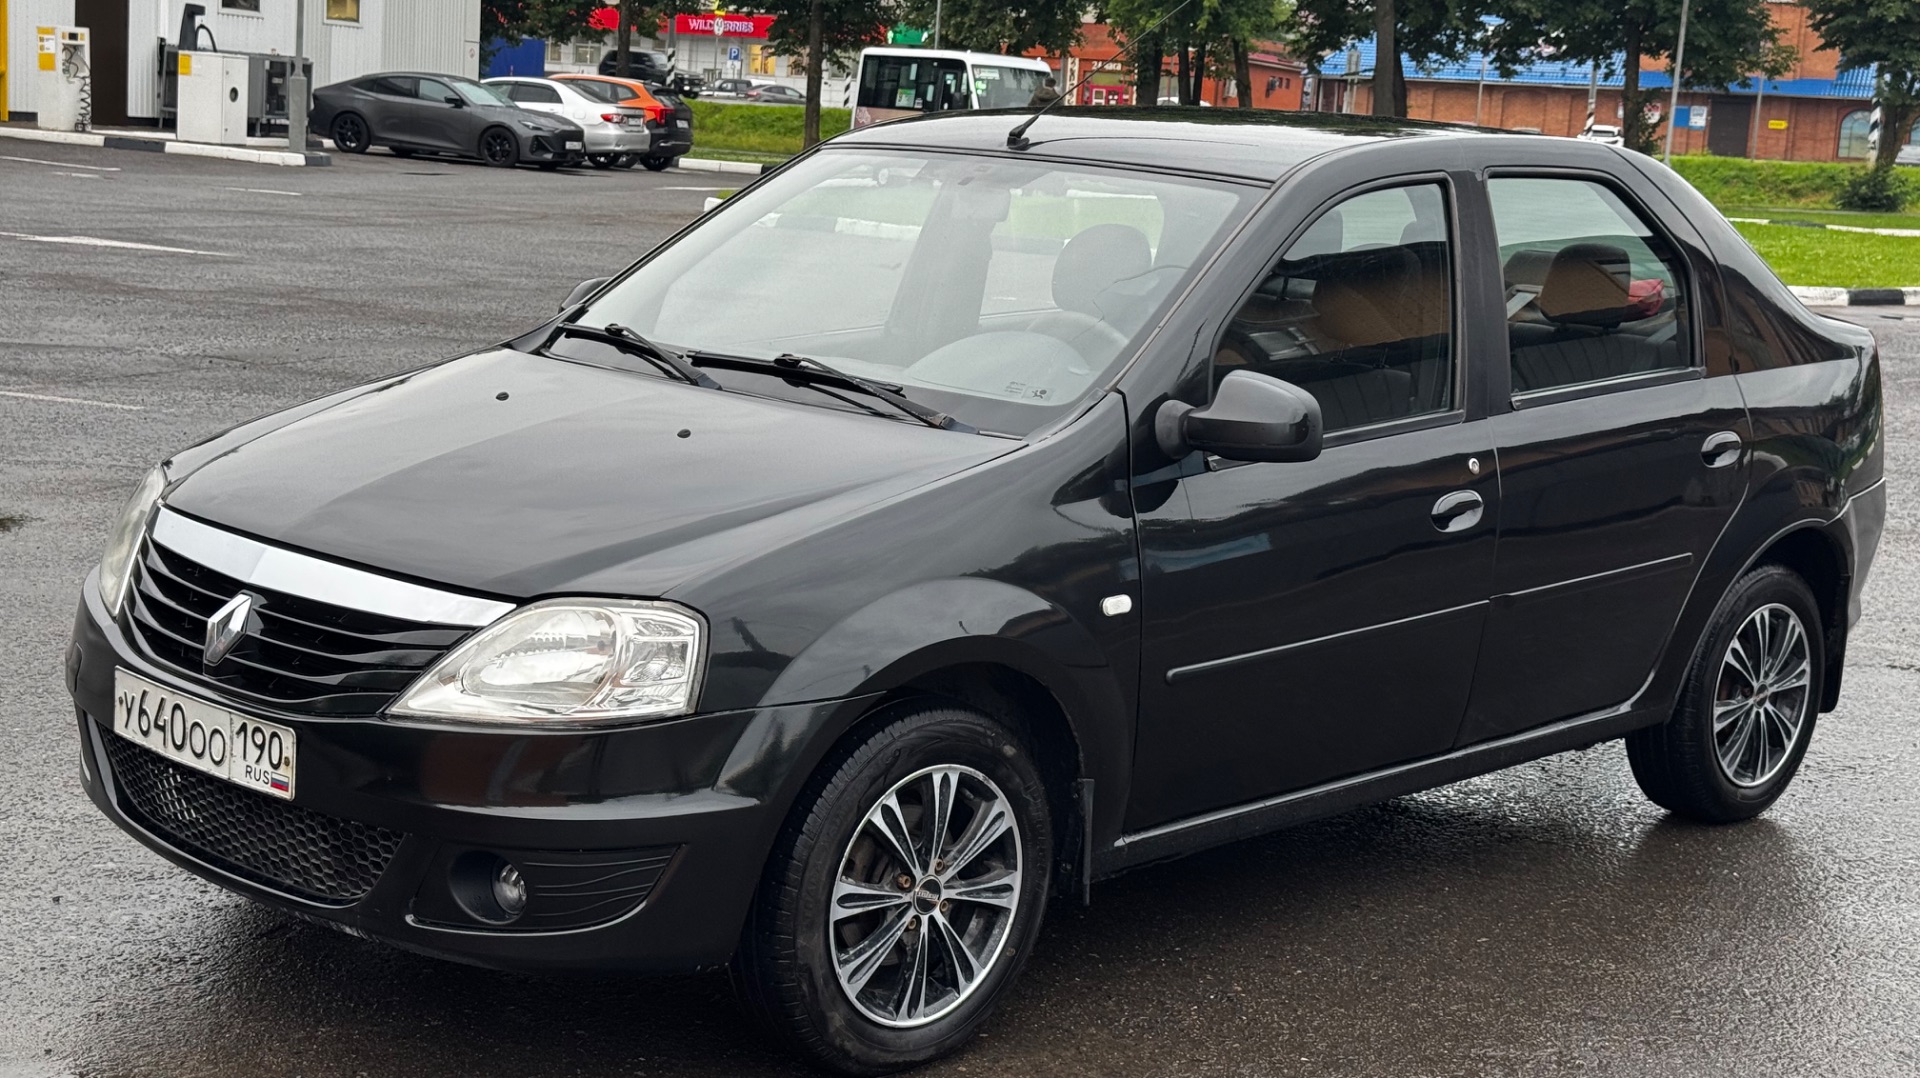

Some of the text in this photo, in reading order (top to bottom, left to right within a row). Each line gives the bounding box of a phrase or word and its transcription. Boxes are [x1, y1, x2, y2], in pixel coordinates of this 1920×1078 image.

[688, 18, 754, 33] WILDERRIES
[731, 48, 738, 59] P
[235, 721, 284, 770] 190
[245, 765, 270, 785] RUS
